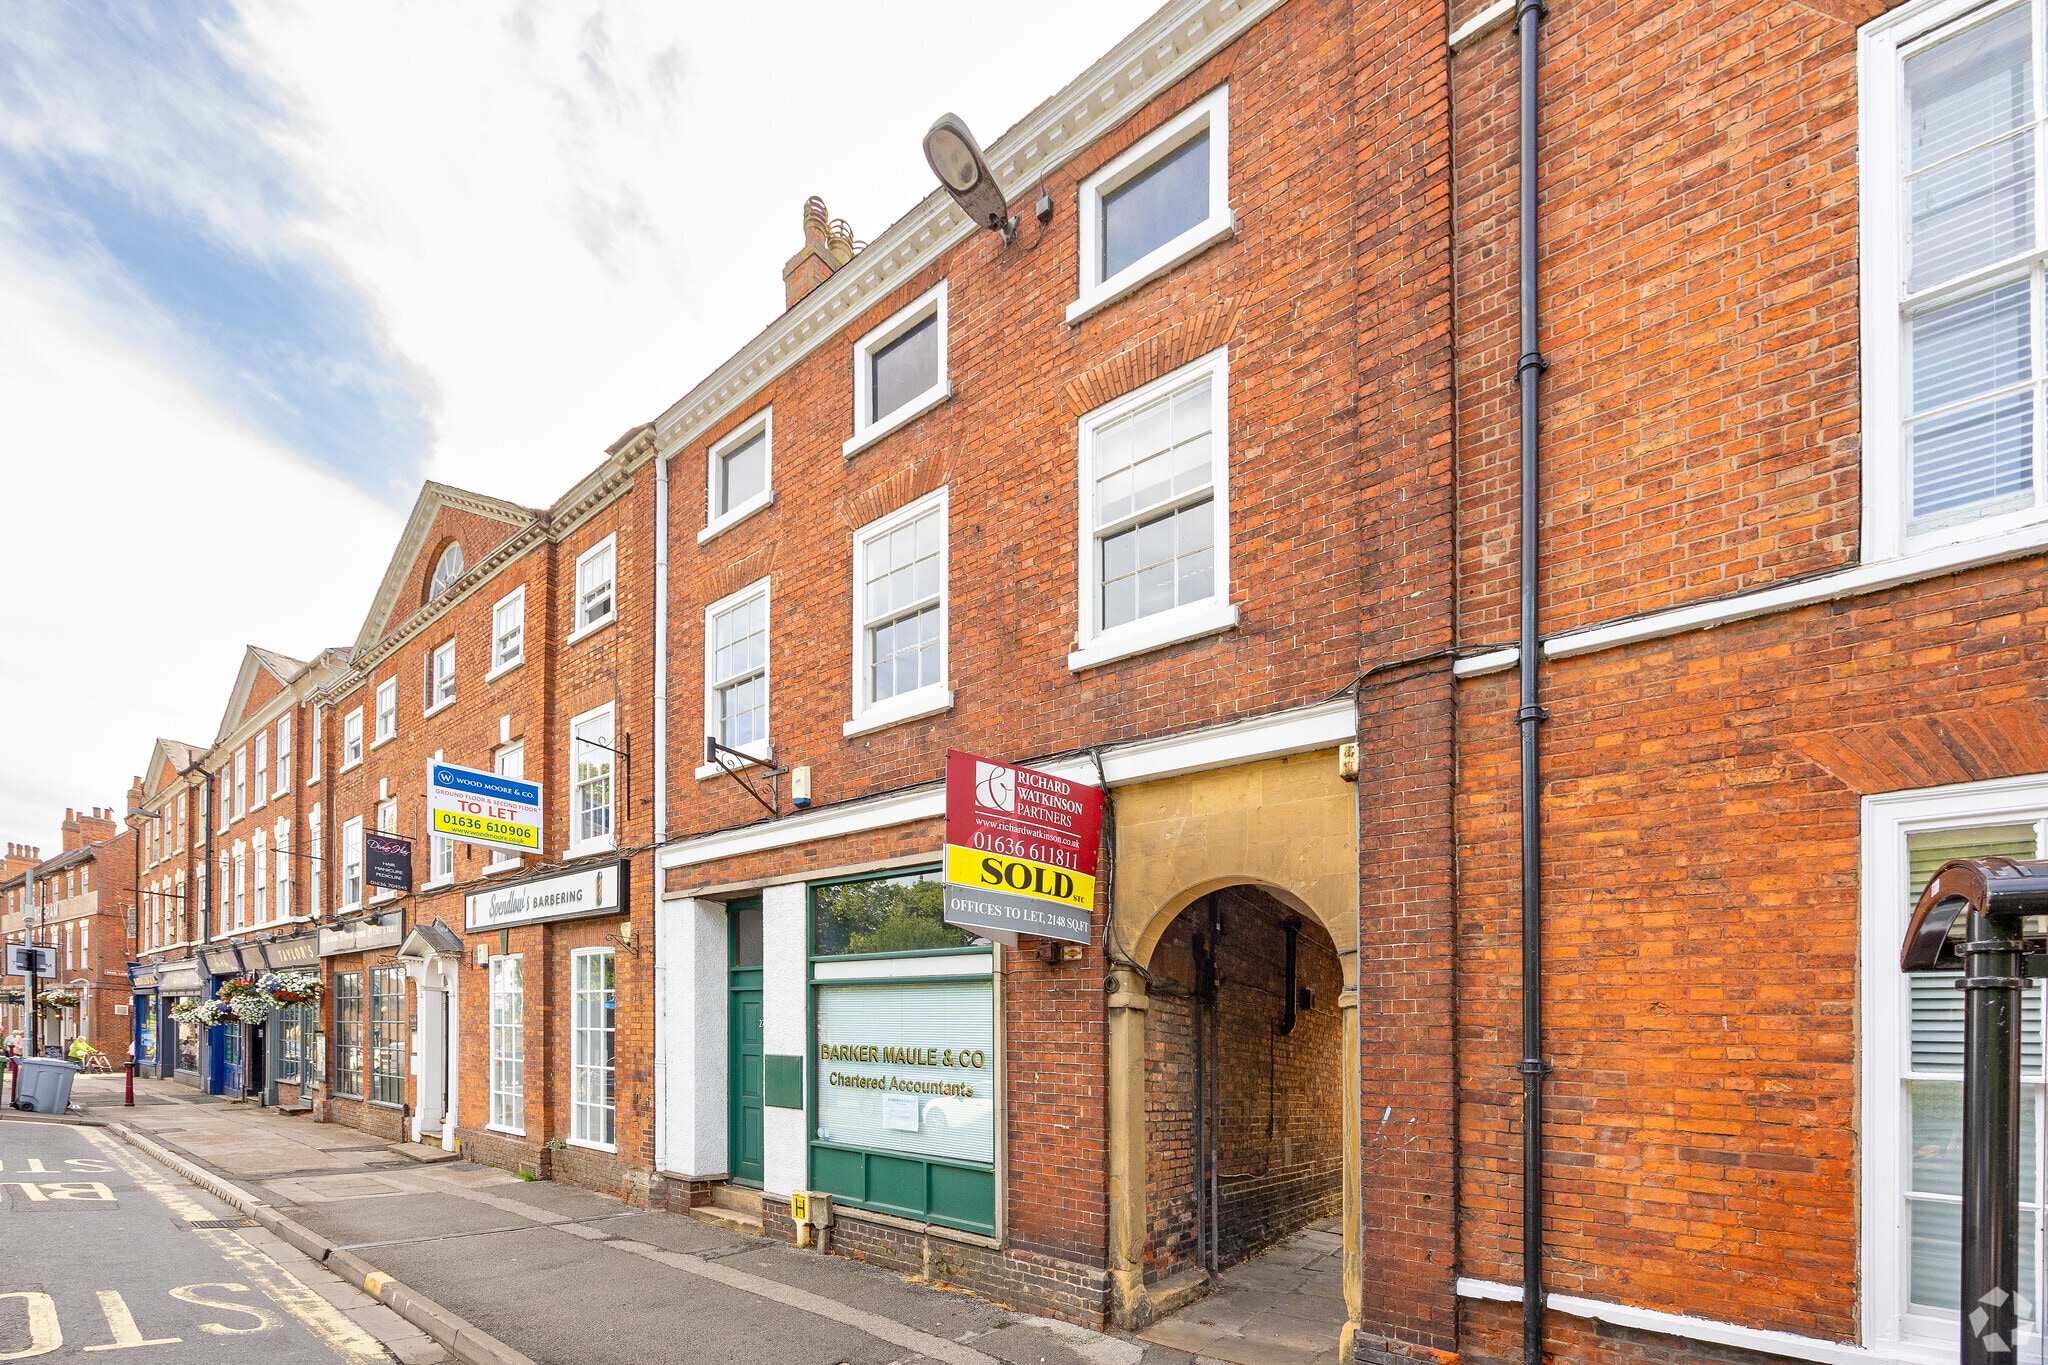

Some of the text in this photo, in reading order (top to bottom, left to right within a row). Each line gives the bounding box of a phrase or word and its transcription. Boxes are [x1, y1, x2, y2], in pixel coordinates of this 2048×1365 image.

[456, 778, 482, 788] WOOD
[484, 784, 512, 795] MOORE
[522, 791, 535, 799] CO.
[1017, 771, 1070, 795] RICHARD
[435, 788, 464, 799] GROUND
[465, 794, 486, 803] FLOOR
[493, 800, 518, 809] SECOND
[518, 805, 538, 813] FLOOR
[458, 800, 518, 821] TO LET
[1017, 787, 1083, 815] WATKINSON
[443, 814, 531, 838] 01636 610906
[1017, 803, 1072, 828] PARTNERS
[451, 828, 525, 844] www.woodmoore.co.uk
[975, 818, 1080, 849] www.richardwatkinson.co.uk
[974, 831, 1078, 870] 01636 611811
[374, 866, 403, 875] MANICURE
[375, 872, 402, 881] PEDICURE
[980, 857, 1085, 904] SOLD STC
[488, 887, 583, 923] Spendlow's BARBERING
[951, 898, 1089, 933] OFFICES TO LET, 2148 SQ.FT
[386, 924, 398, 933] TABLE
[277, 944, 314, 962] TAYLOR'S
[821, 1043, 986, 1068] BARKER MAULE & CO
[829, 1071, 974, 1097] Chartered Accountants
[795, 1197, 806, 1218] H
